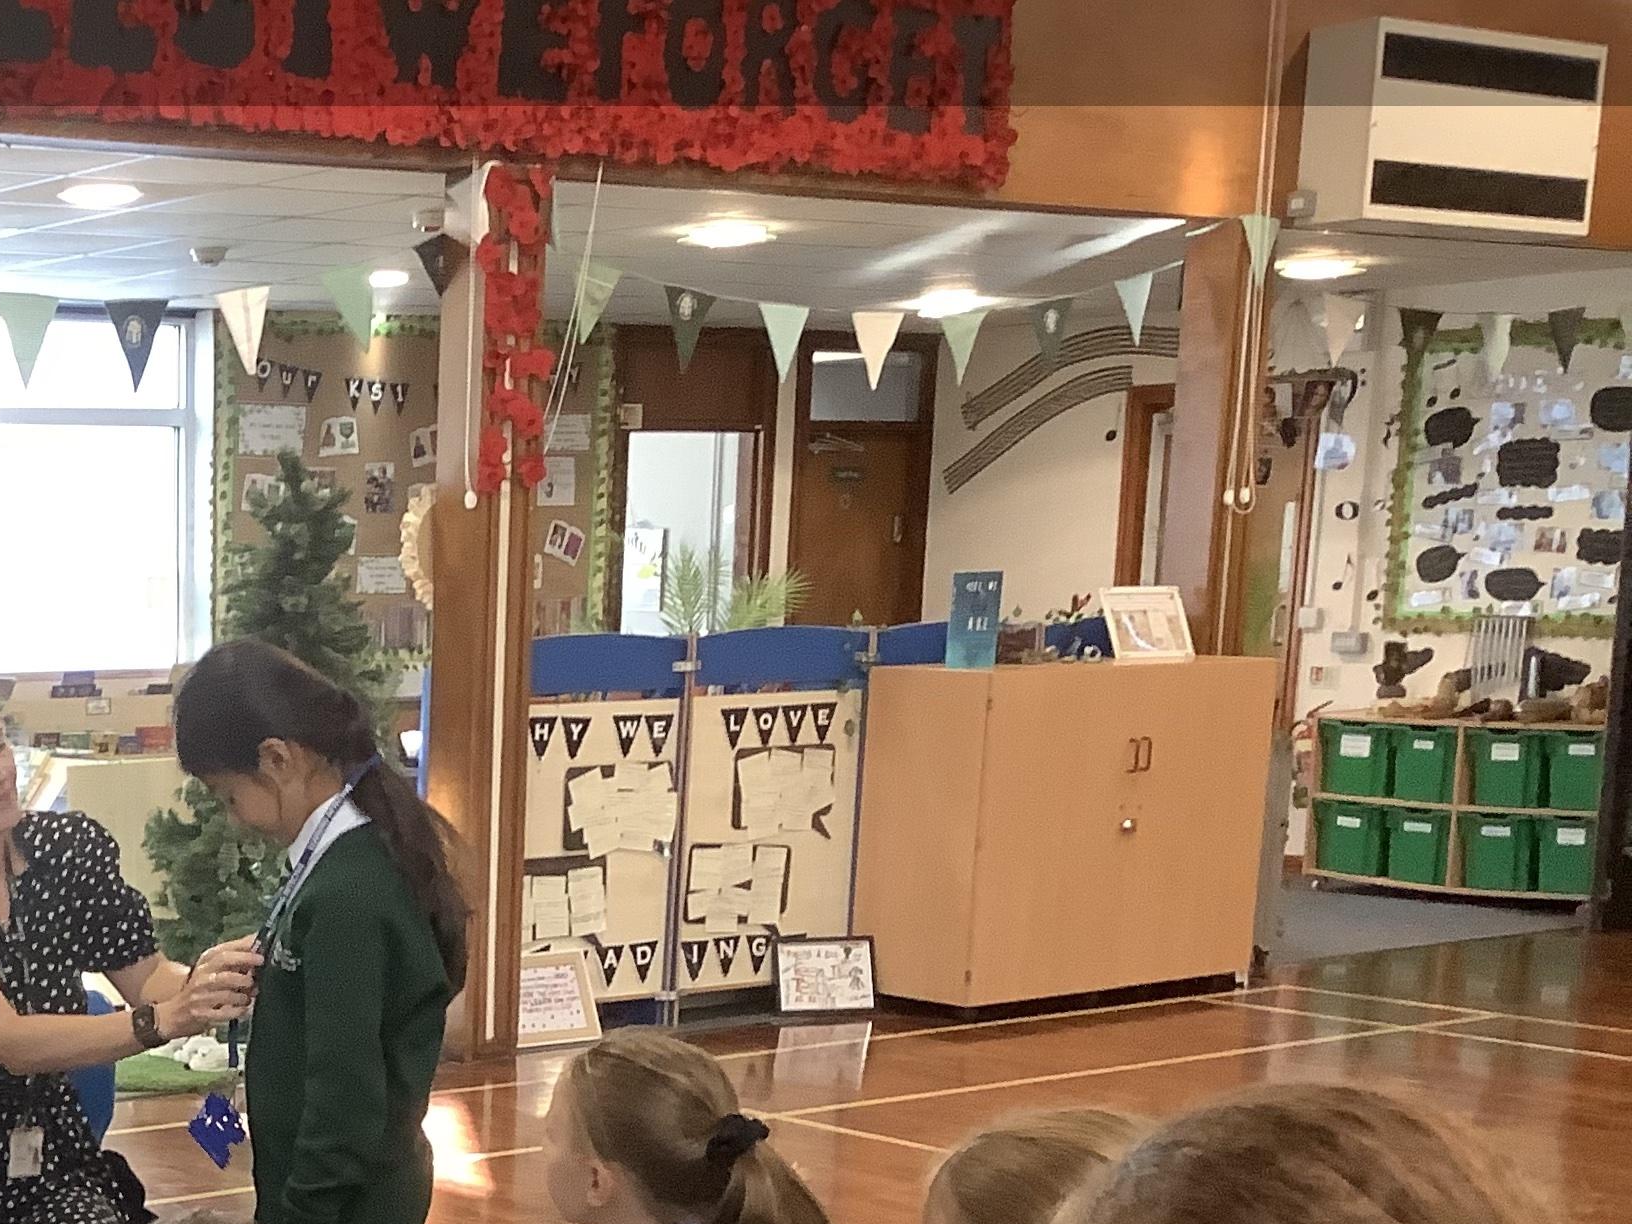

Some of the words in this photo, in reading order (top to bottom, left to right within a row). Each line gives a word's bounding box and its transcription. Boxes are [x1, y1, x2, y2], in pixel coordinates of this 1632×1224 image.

[596, 0, 1002, 136] FORGET
[348, 378, 404, 402] KS1
[619, 719, 667, 740] WE
[729, 706, 830, 732] LOVE
